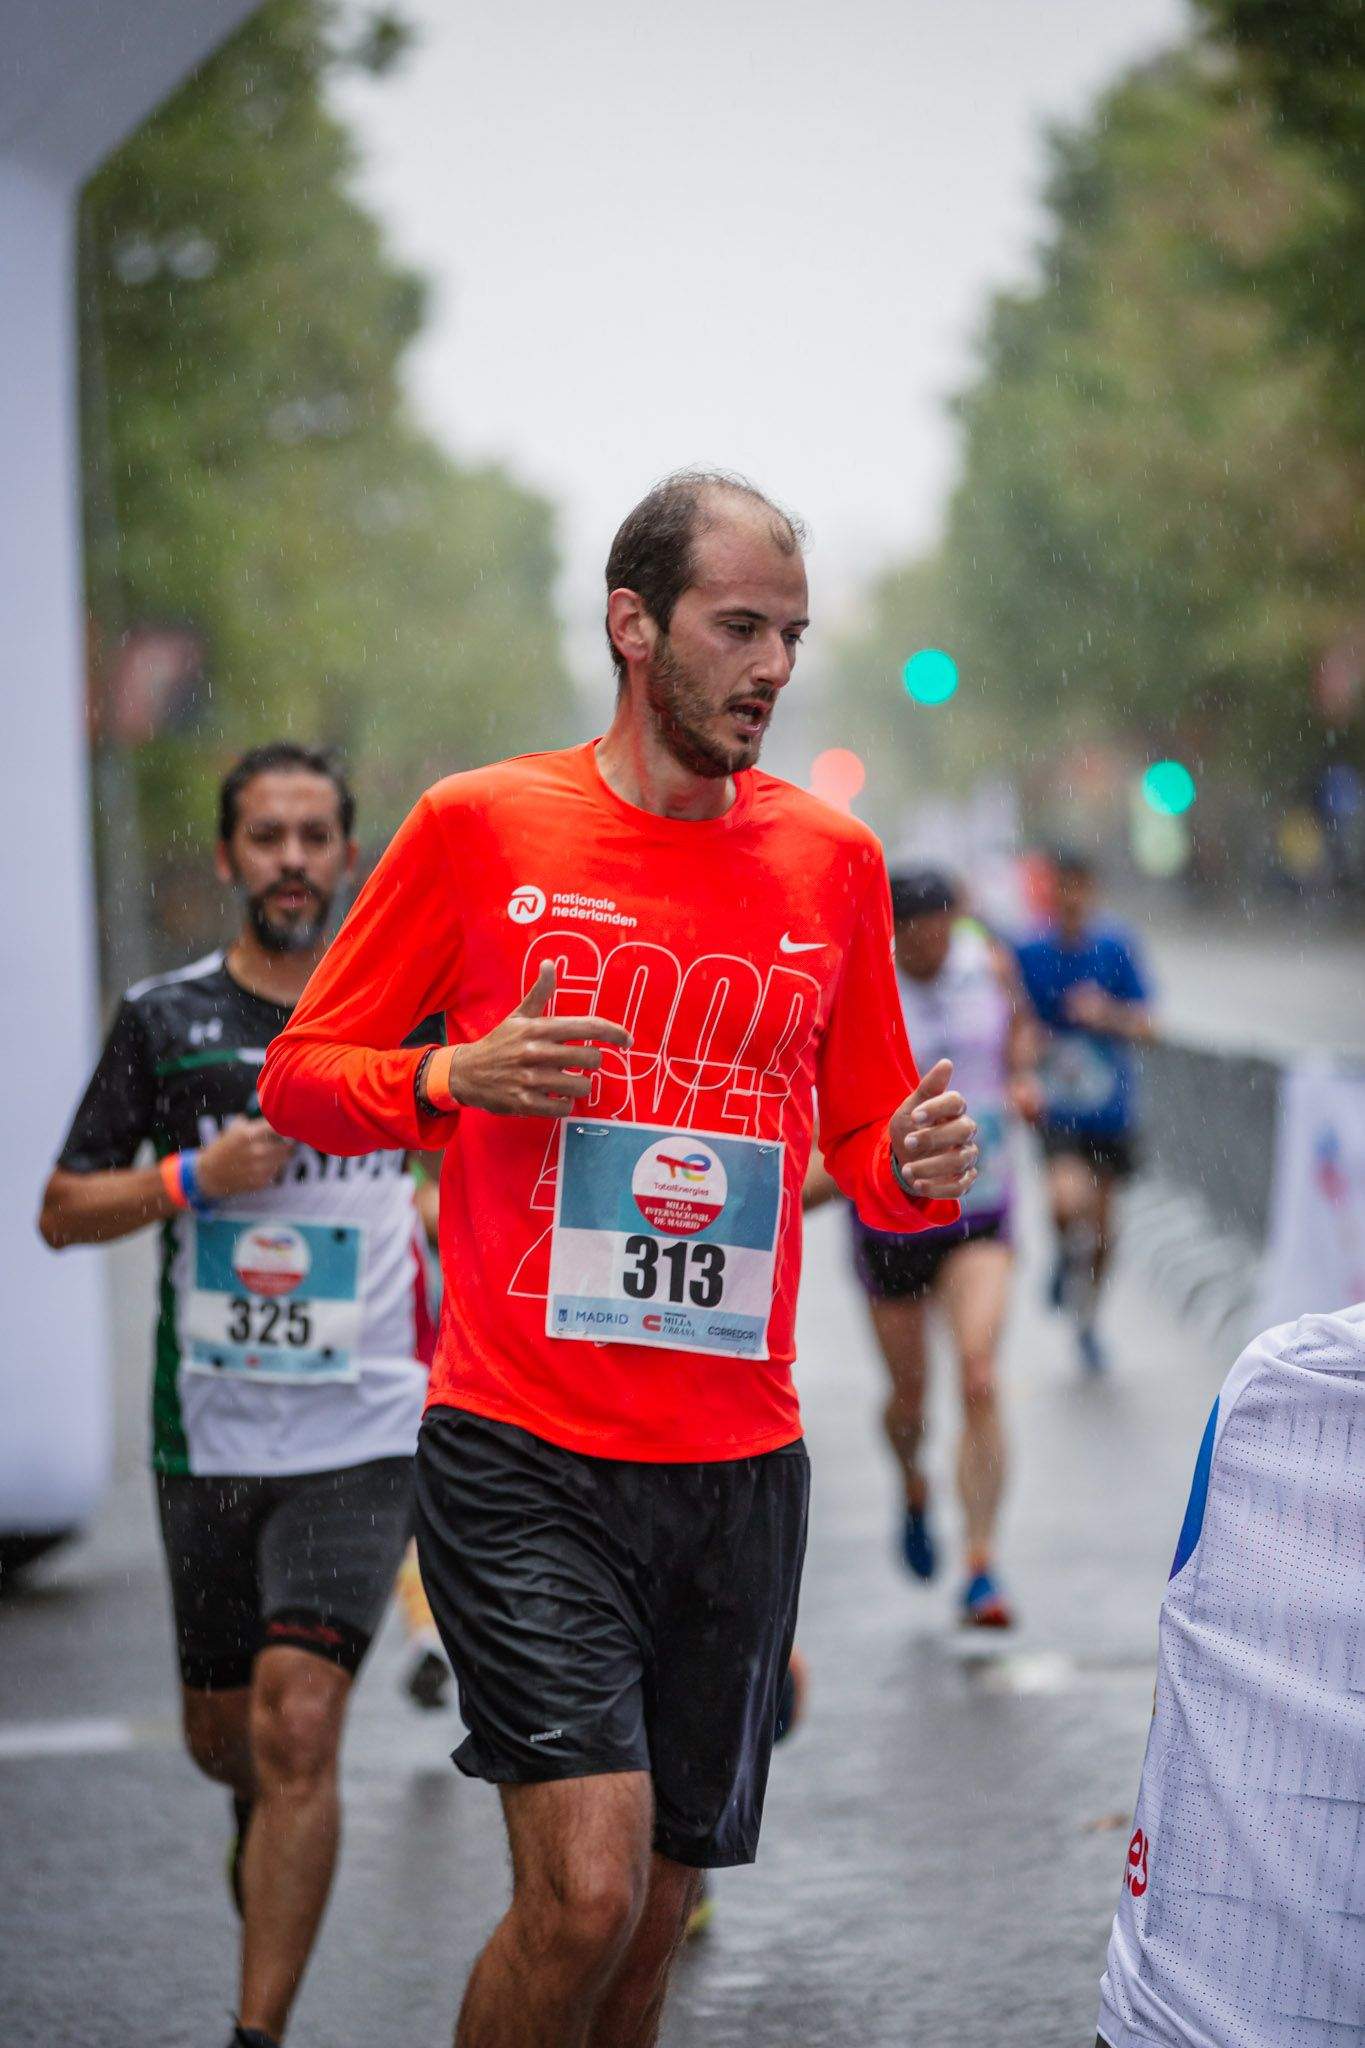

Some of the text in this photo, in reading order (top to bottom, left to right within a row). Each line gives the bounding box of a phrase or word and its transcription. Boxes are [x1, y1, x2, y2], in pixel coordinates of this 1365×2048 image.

[552, 893, 616, 911] nationale
[552, 905, 638, 927] nederlanden
[520, 930, 824, 1096] GOOD
[654, 1183, 709, 1197] TotalEnergies
[665, 1201, 693, 1212] MILLA
[653, 1217, 701, 1230] DE MADRID
[622, 1235, 726, 1309] 313
[229, 1299, 312, 1348] 325
[576, 1311, 629, 1326] MADRID
[664, 1316, 692, 1328] MILLA
[707, 1326, 757, 1341] CORREDOR
